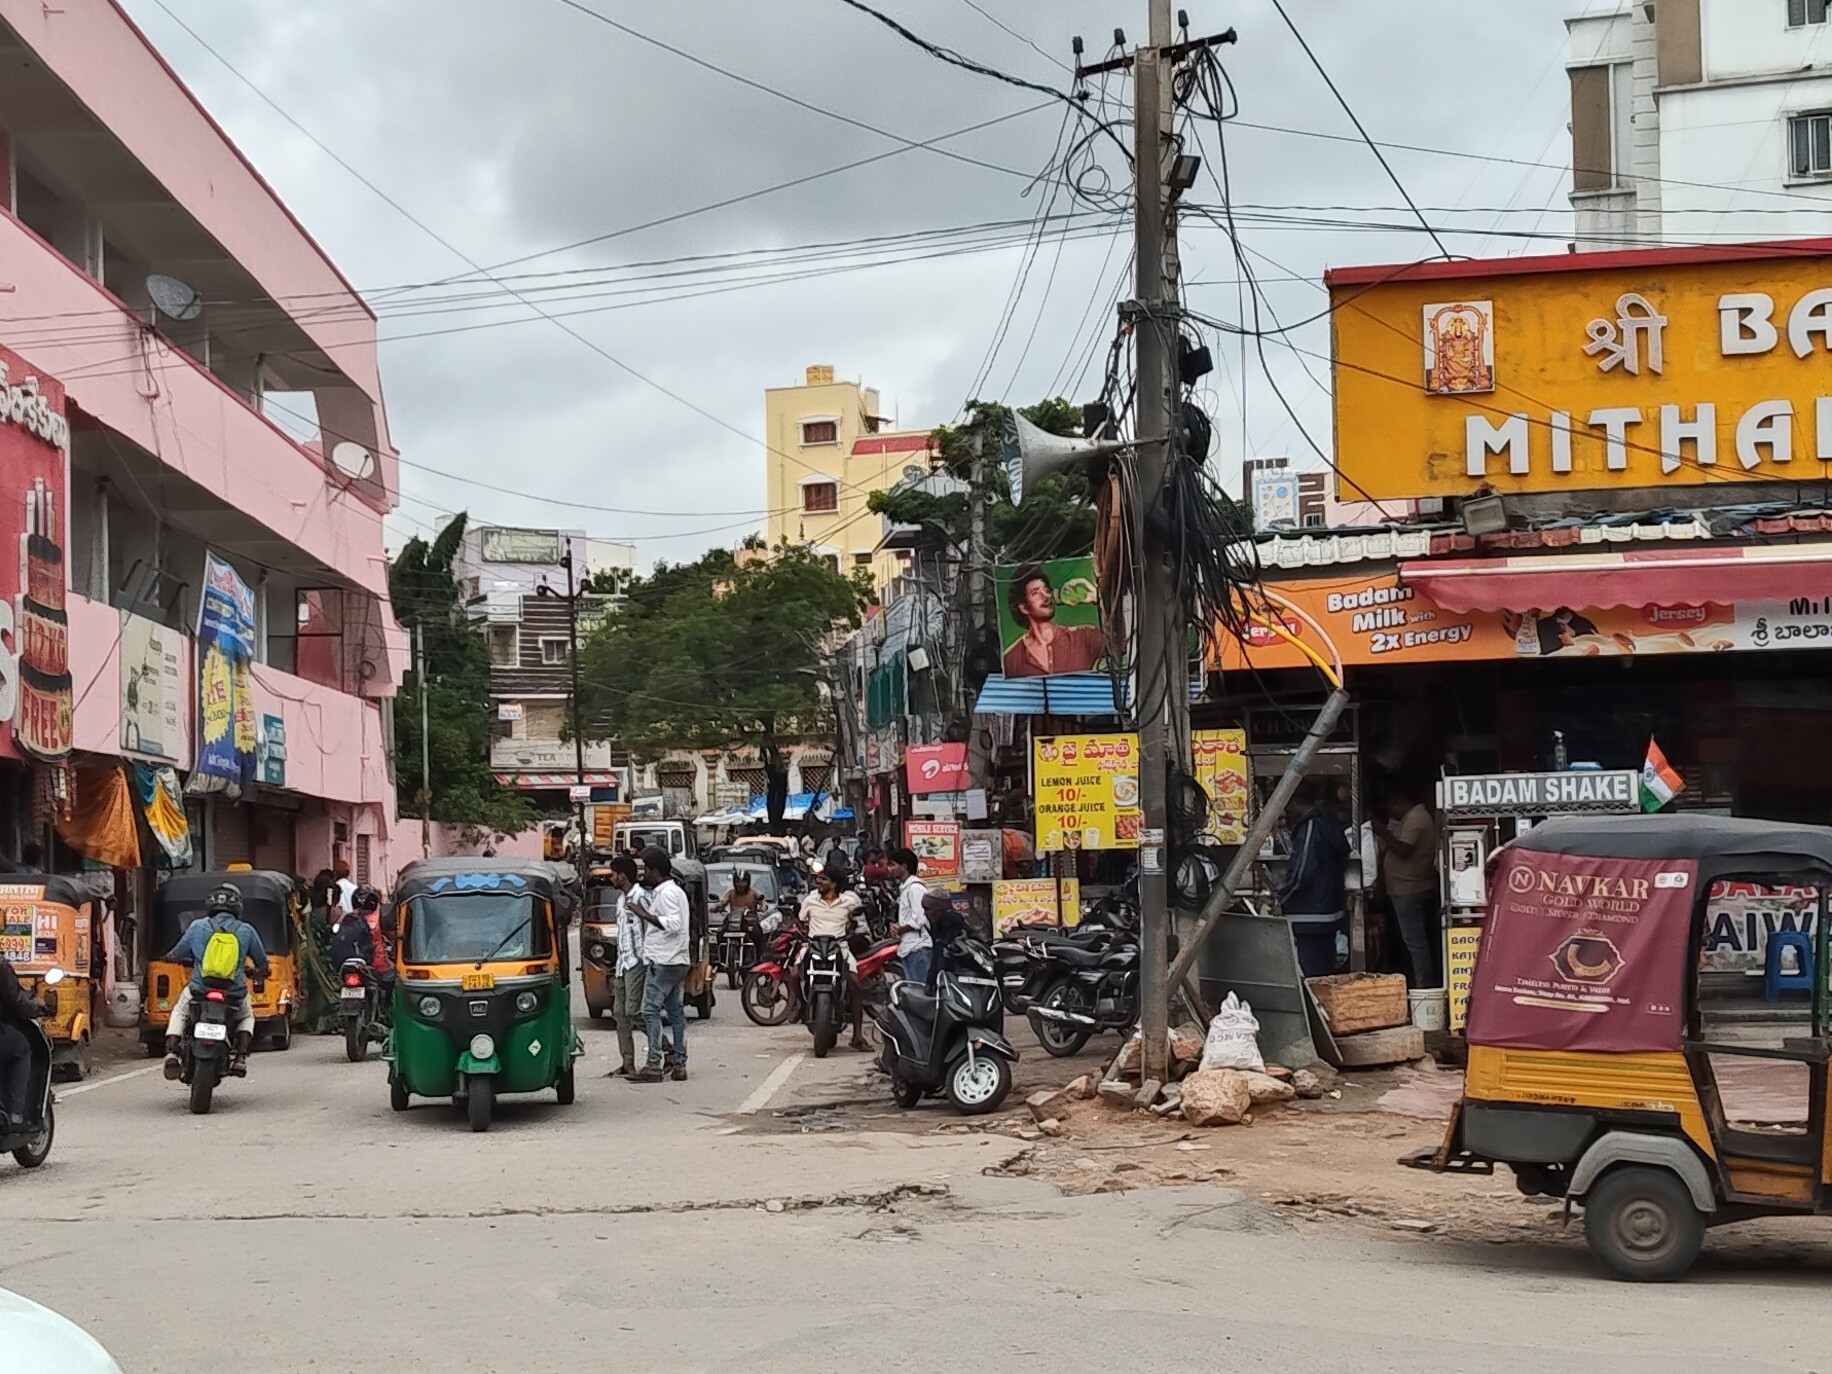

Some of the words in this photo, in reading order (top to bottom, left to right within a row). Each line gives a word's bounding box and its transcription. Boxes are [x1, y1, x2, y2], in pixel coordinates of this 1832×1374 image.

[1581, 293, 1668, 375] श्री
[1327, 587, 1413, 613] Badam
[1352, 608, 1407, 633] Milk
[1408, 610, 1436, 624] with
[1650, 606, 1706, 622] Jersey
[1370, 633, 1401, 653] 2x
[1404, 623, 1472, 648] Energy
[1774, 624, 1832, 640] బాలా
[1041, 777, 1072, 787] LEMON
[1075, 776, 1101, 786] JUICE
[1056, 788, 1087, 801] 10/-
[1453, 779, 1538, 806] BADAM
[1545, 775, 1628, 802] SHAKE
[1039, 803, 1076, 813] ORANGE
[1078, 802, 1105, 812] JUICE
[1057, 815, 1087, 828] 10/-
[1536, 870, 1649, 899] NAVKAR
[1543, 895, 1584, 908] GOLD
[1586, 899, 1640, 912] WORLD
